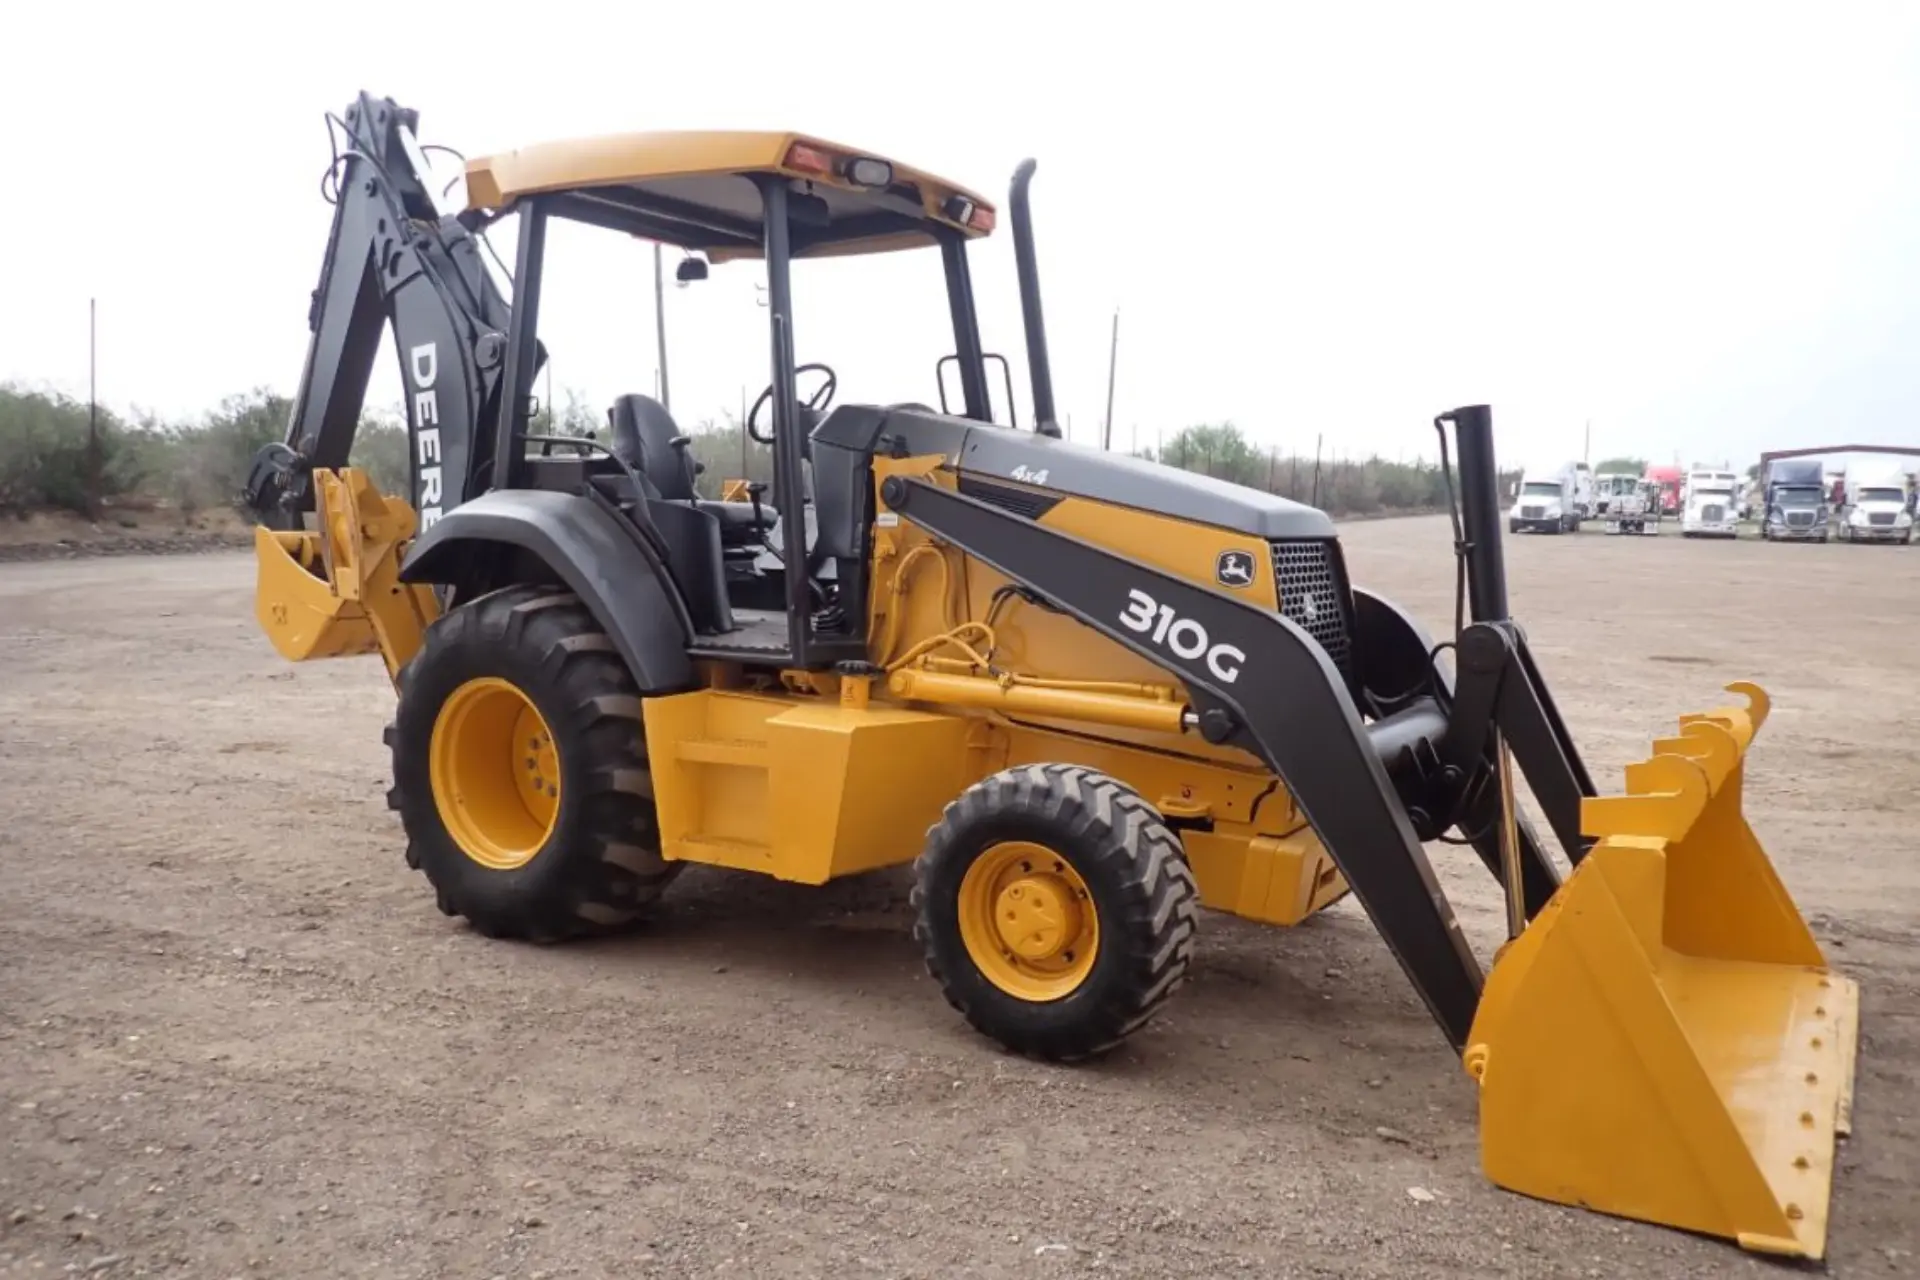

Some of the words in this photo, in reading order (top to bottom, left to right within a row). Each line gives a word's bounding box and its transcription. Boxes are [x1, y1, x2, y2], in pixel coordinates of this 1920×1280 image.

[411, 342, 442, 535] DEERE
[1010, 464, 1050, 485] 4x4
[1118, 588, 1246, 684] 310G
